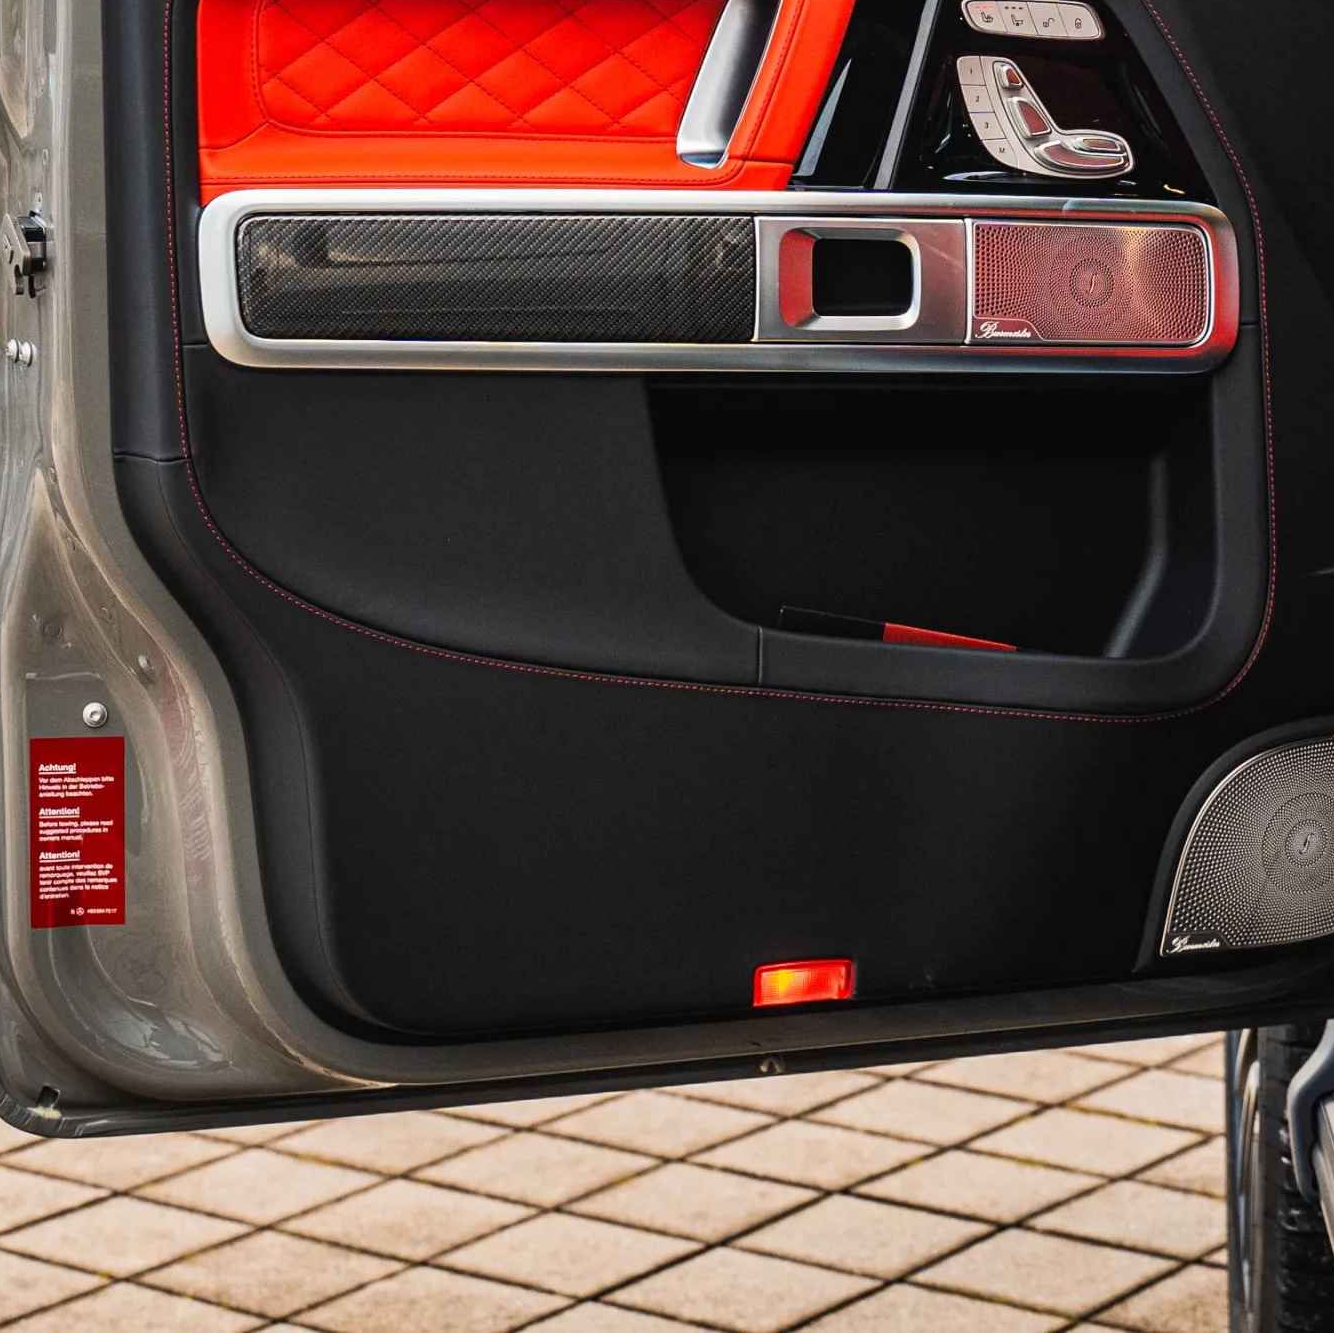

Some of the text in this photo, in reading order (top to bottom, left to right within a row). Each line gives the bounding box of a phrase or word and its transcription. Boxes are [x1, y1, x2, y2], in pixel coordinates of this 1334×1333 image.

[975, 95, 980, 103] 2
[974, 321, 1032, 339] Burmester
[39, 763, 76, 771] Achtung!
[39, 807, 80, 815] Attention!
[39, 850, 80, 859] Attention!
